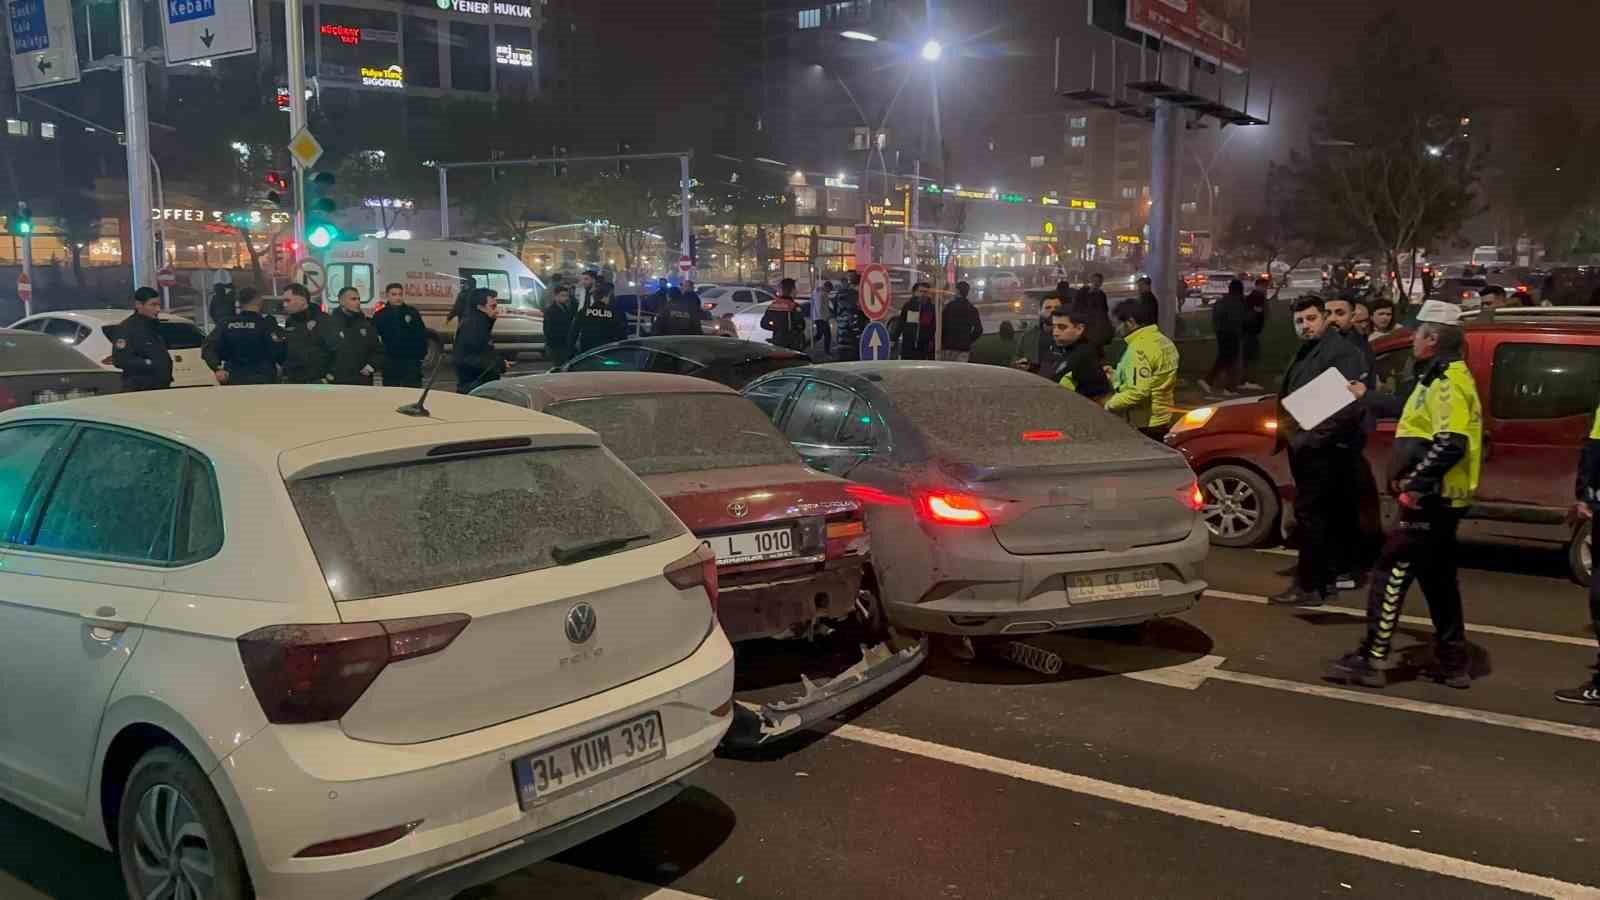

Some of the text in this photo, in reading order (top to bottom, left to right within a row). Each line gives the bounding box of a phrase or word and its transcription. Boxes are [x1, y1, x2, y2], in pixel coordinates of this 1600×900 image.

[169, 0, 213, 17] Keban
[452, 0, 533, 18] YENER HUKUK
[754, 530, 791, 553] 1010
[533, 756, 563, 792] 34
[570, 735, 613, 778] KUM
[620, 718, 660, 758] 332
